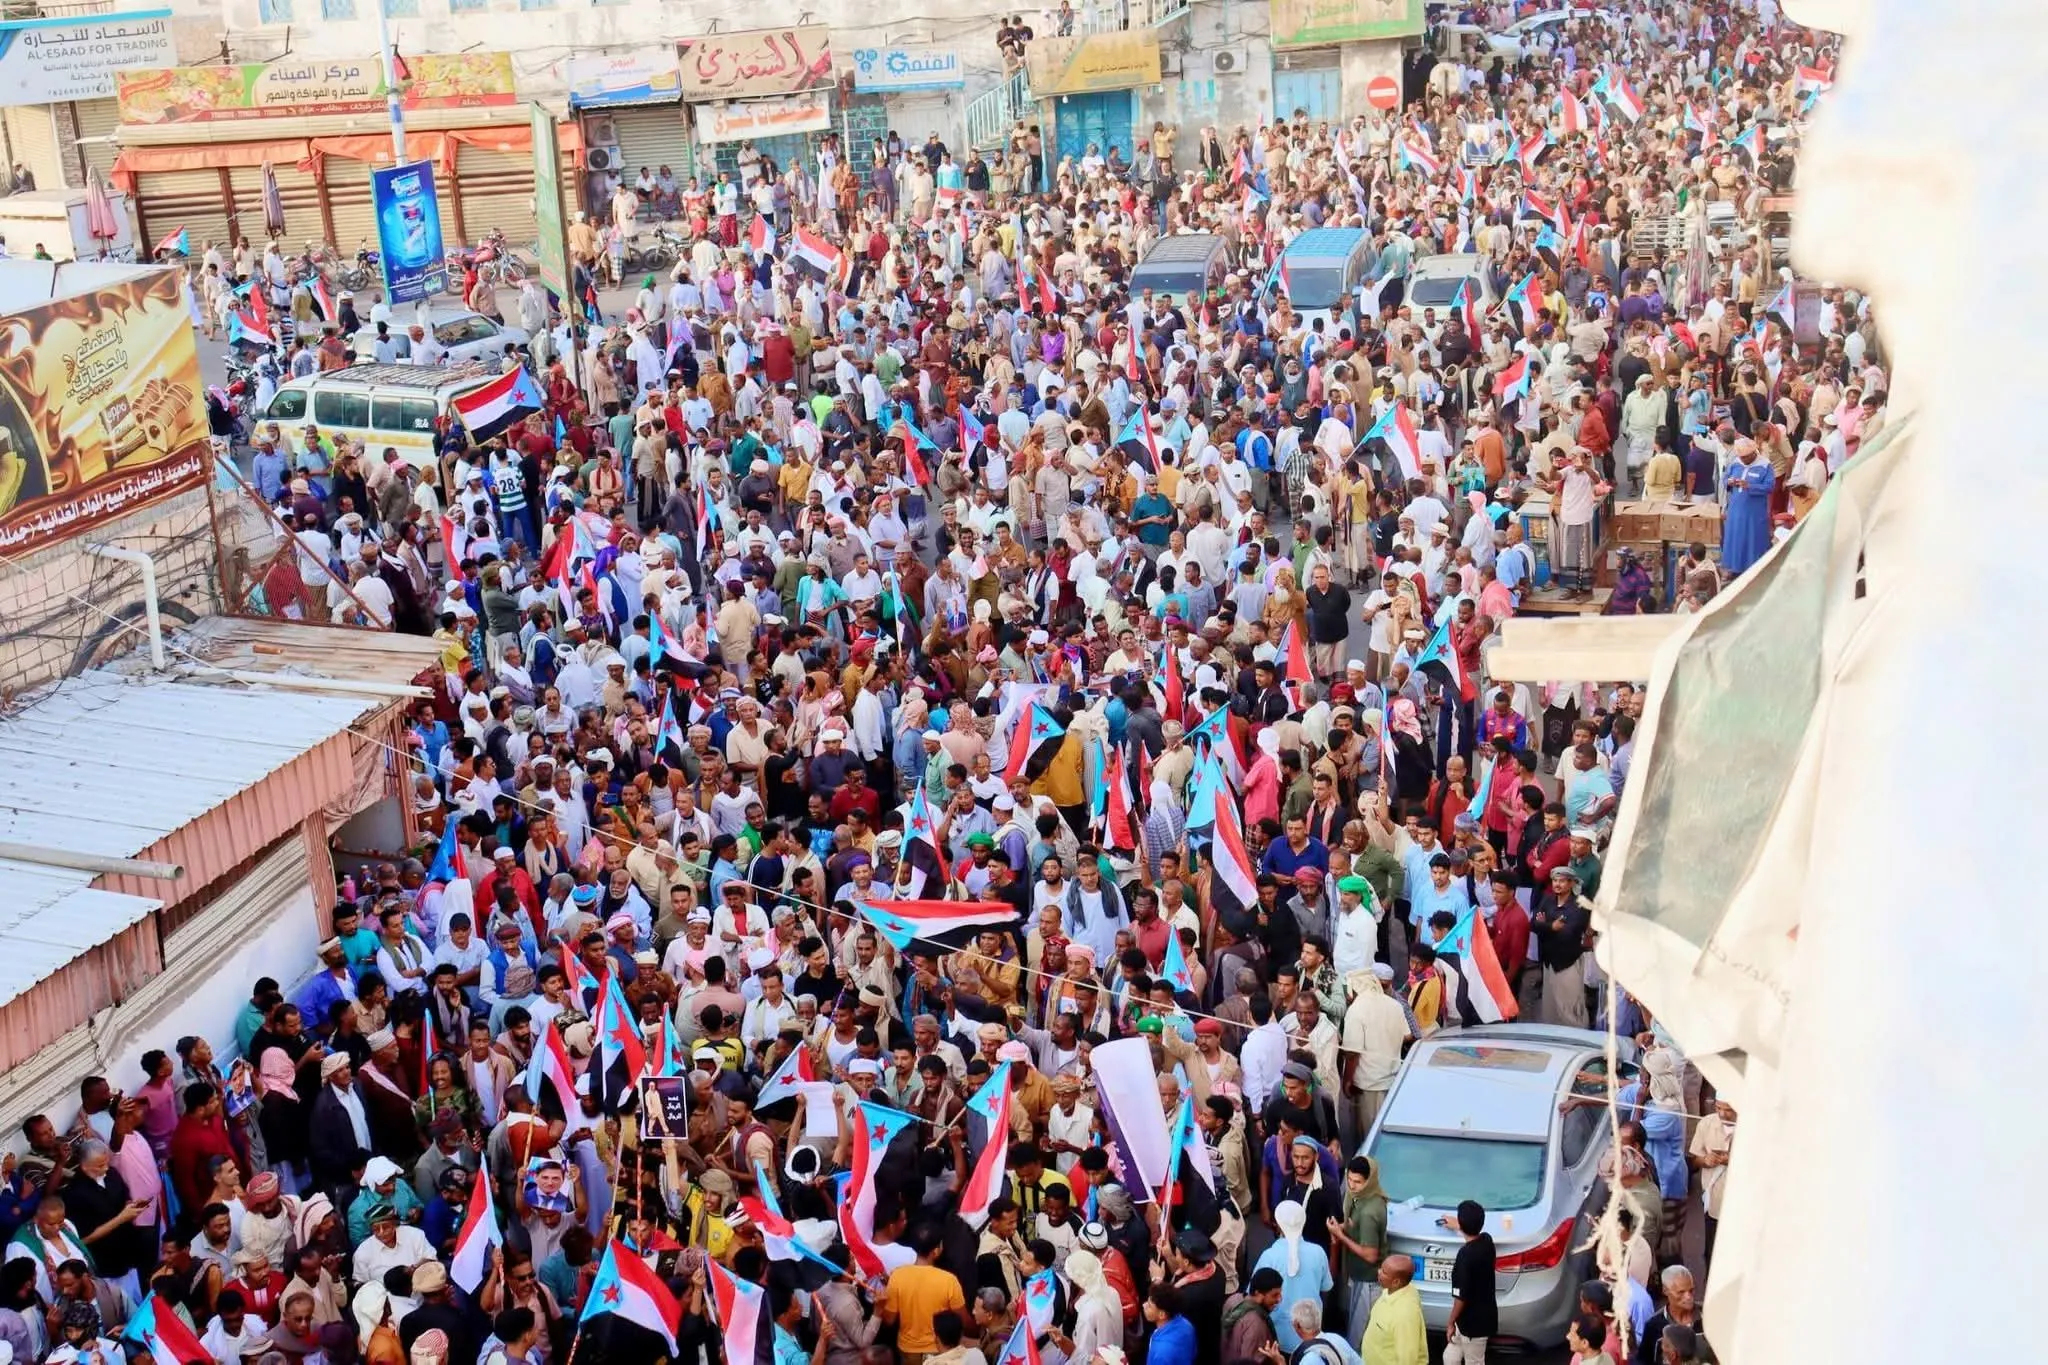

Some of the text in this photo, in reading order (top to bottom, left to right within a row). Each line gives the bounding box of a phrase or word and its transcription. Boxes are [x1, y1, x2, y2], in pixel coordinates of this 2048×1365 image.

[23, 27, 90, 48] للتجارة
[27, 38, 168, 60] AL-ESAAD FOR TRADING
[269, 65, 360, 84] مركز الميناء
[75, 320, 123, 369] إستمتع
[105, 482, 127, 513] لبيع
[126, 467, 163, 500] للتجارة
[499, 478, 515, 493] 28
[34, 500, 80, 536] الغذائية
[80, 490, 105, 518] المواد
